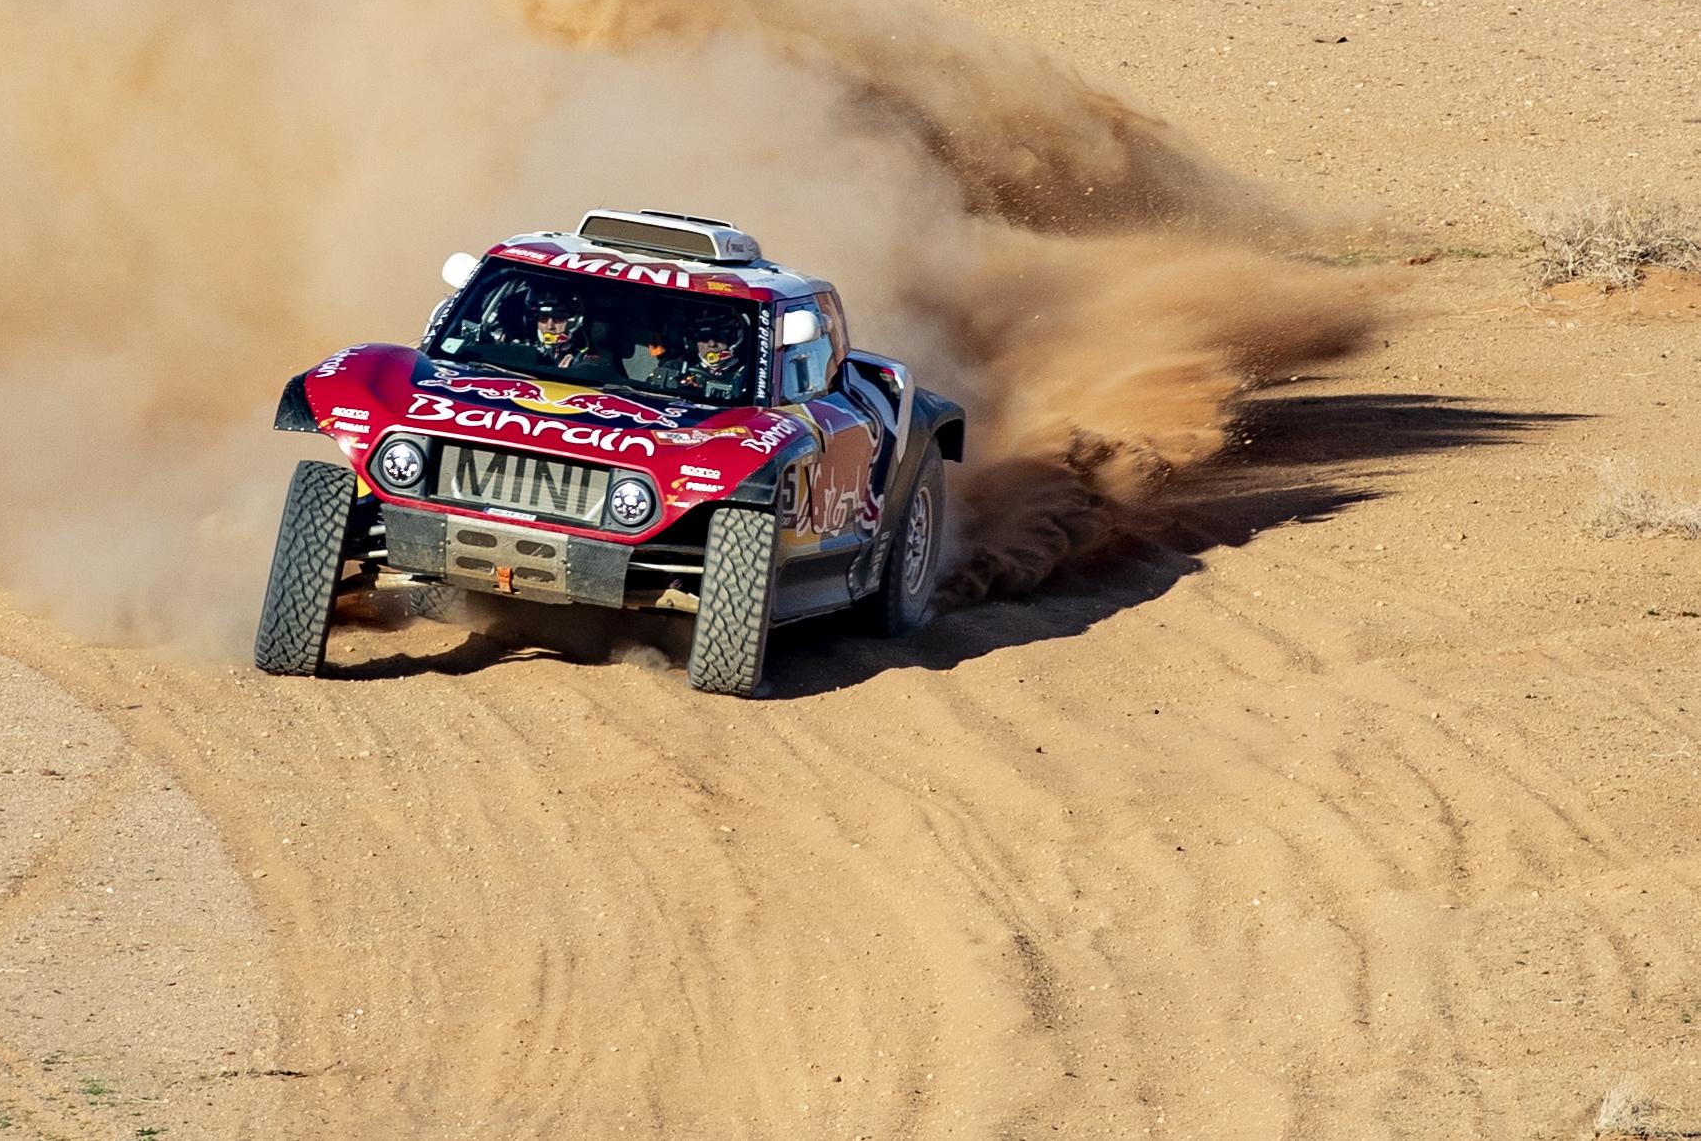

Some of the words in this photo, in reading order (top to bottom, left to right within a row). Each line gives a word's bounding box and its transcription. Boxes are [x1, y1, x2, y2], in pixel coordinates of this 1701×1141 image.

[548, 252, 690, 289] MINI
[757, 309, 771, 400] www.x-raid.de
[406, 393, 655, 457] Bahrain
[740, 412, 800, 455] Bahrain
[455, 445, 592, 515] MINI
